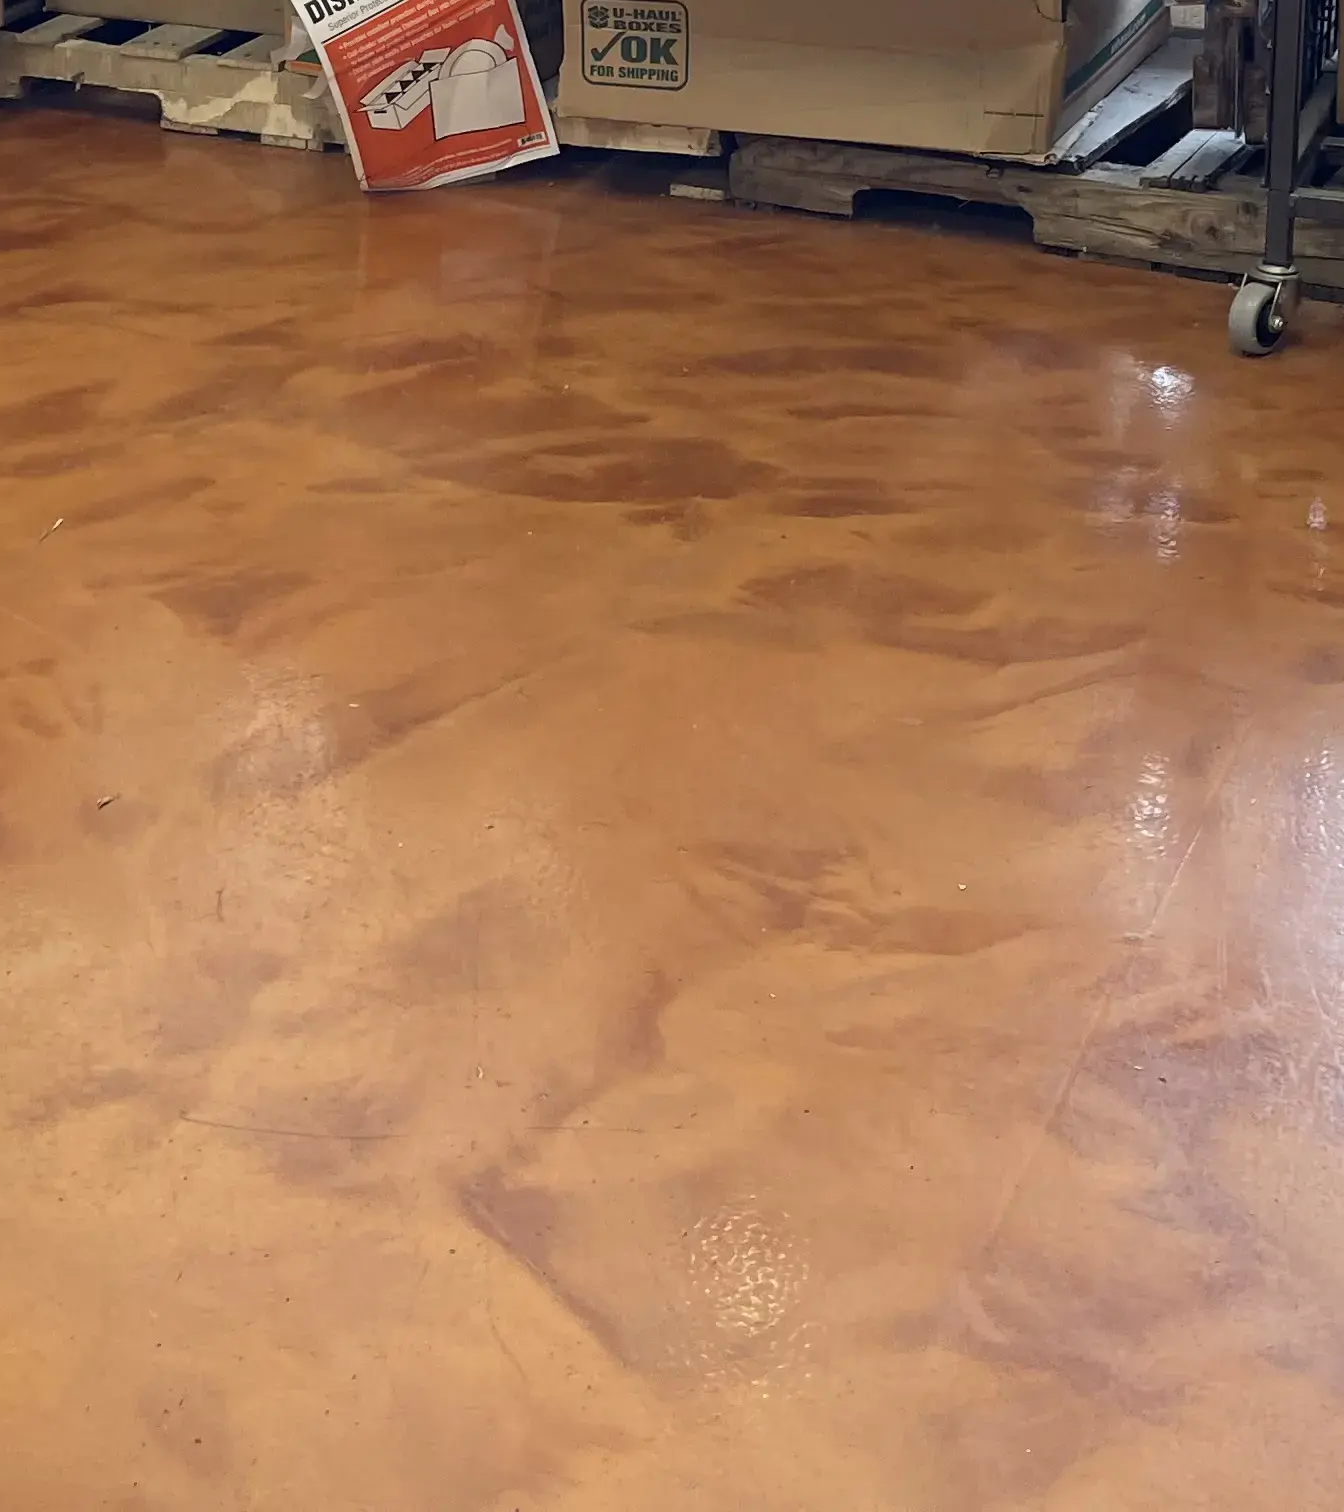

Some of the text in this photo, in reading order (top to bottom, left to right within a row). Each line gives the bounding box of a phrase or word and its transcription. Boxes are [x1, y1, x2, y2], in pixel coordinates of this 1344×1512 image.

[327, 11, 359, 33] Superior
[612, 8, 681, 22] U-HAUL
[614, 20, 682, 33] BOXES
[621, 36, 679, 66] OK
[590, 65, 679, 82] FOR SHIPPING
